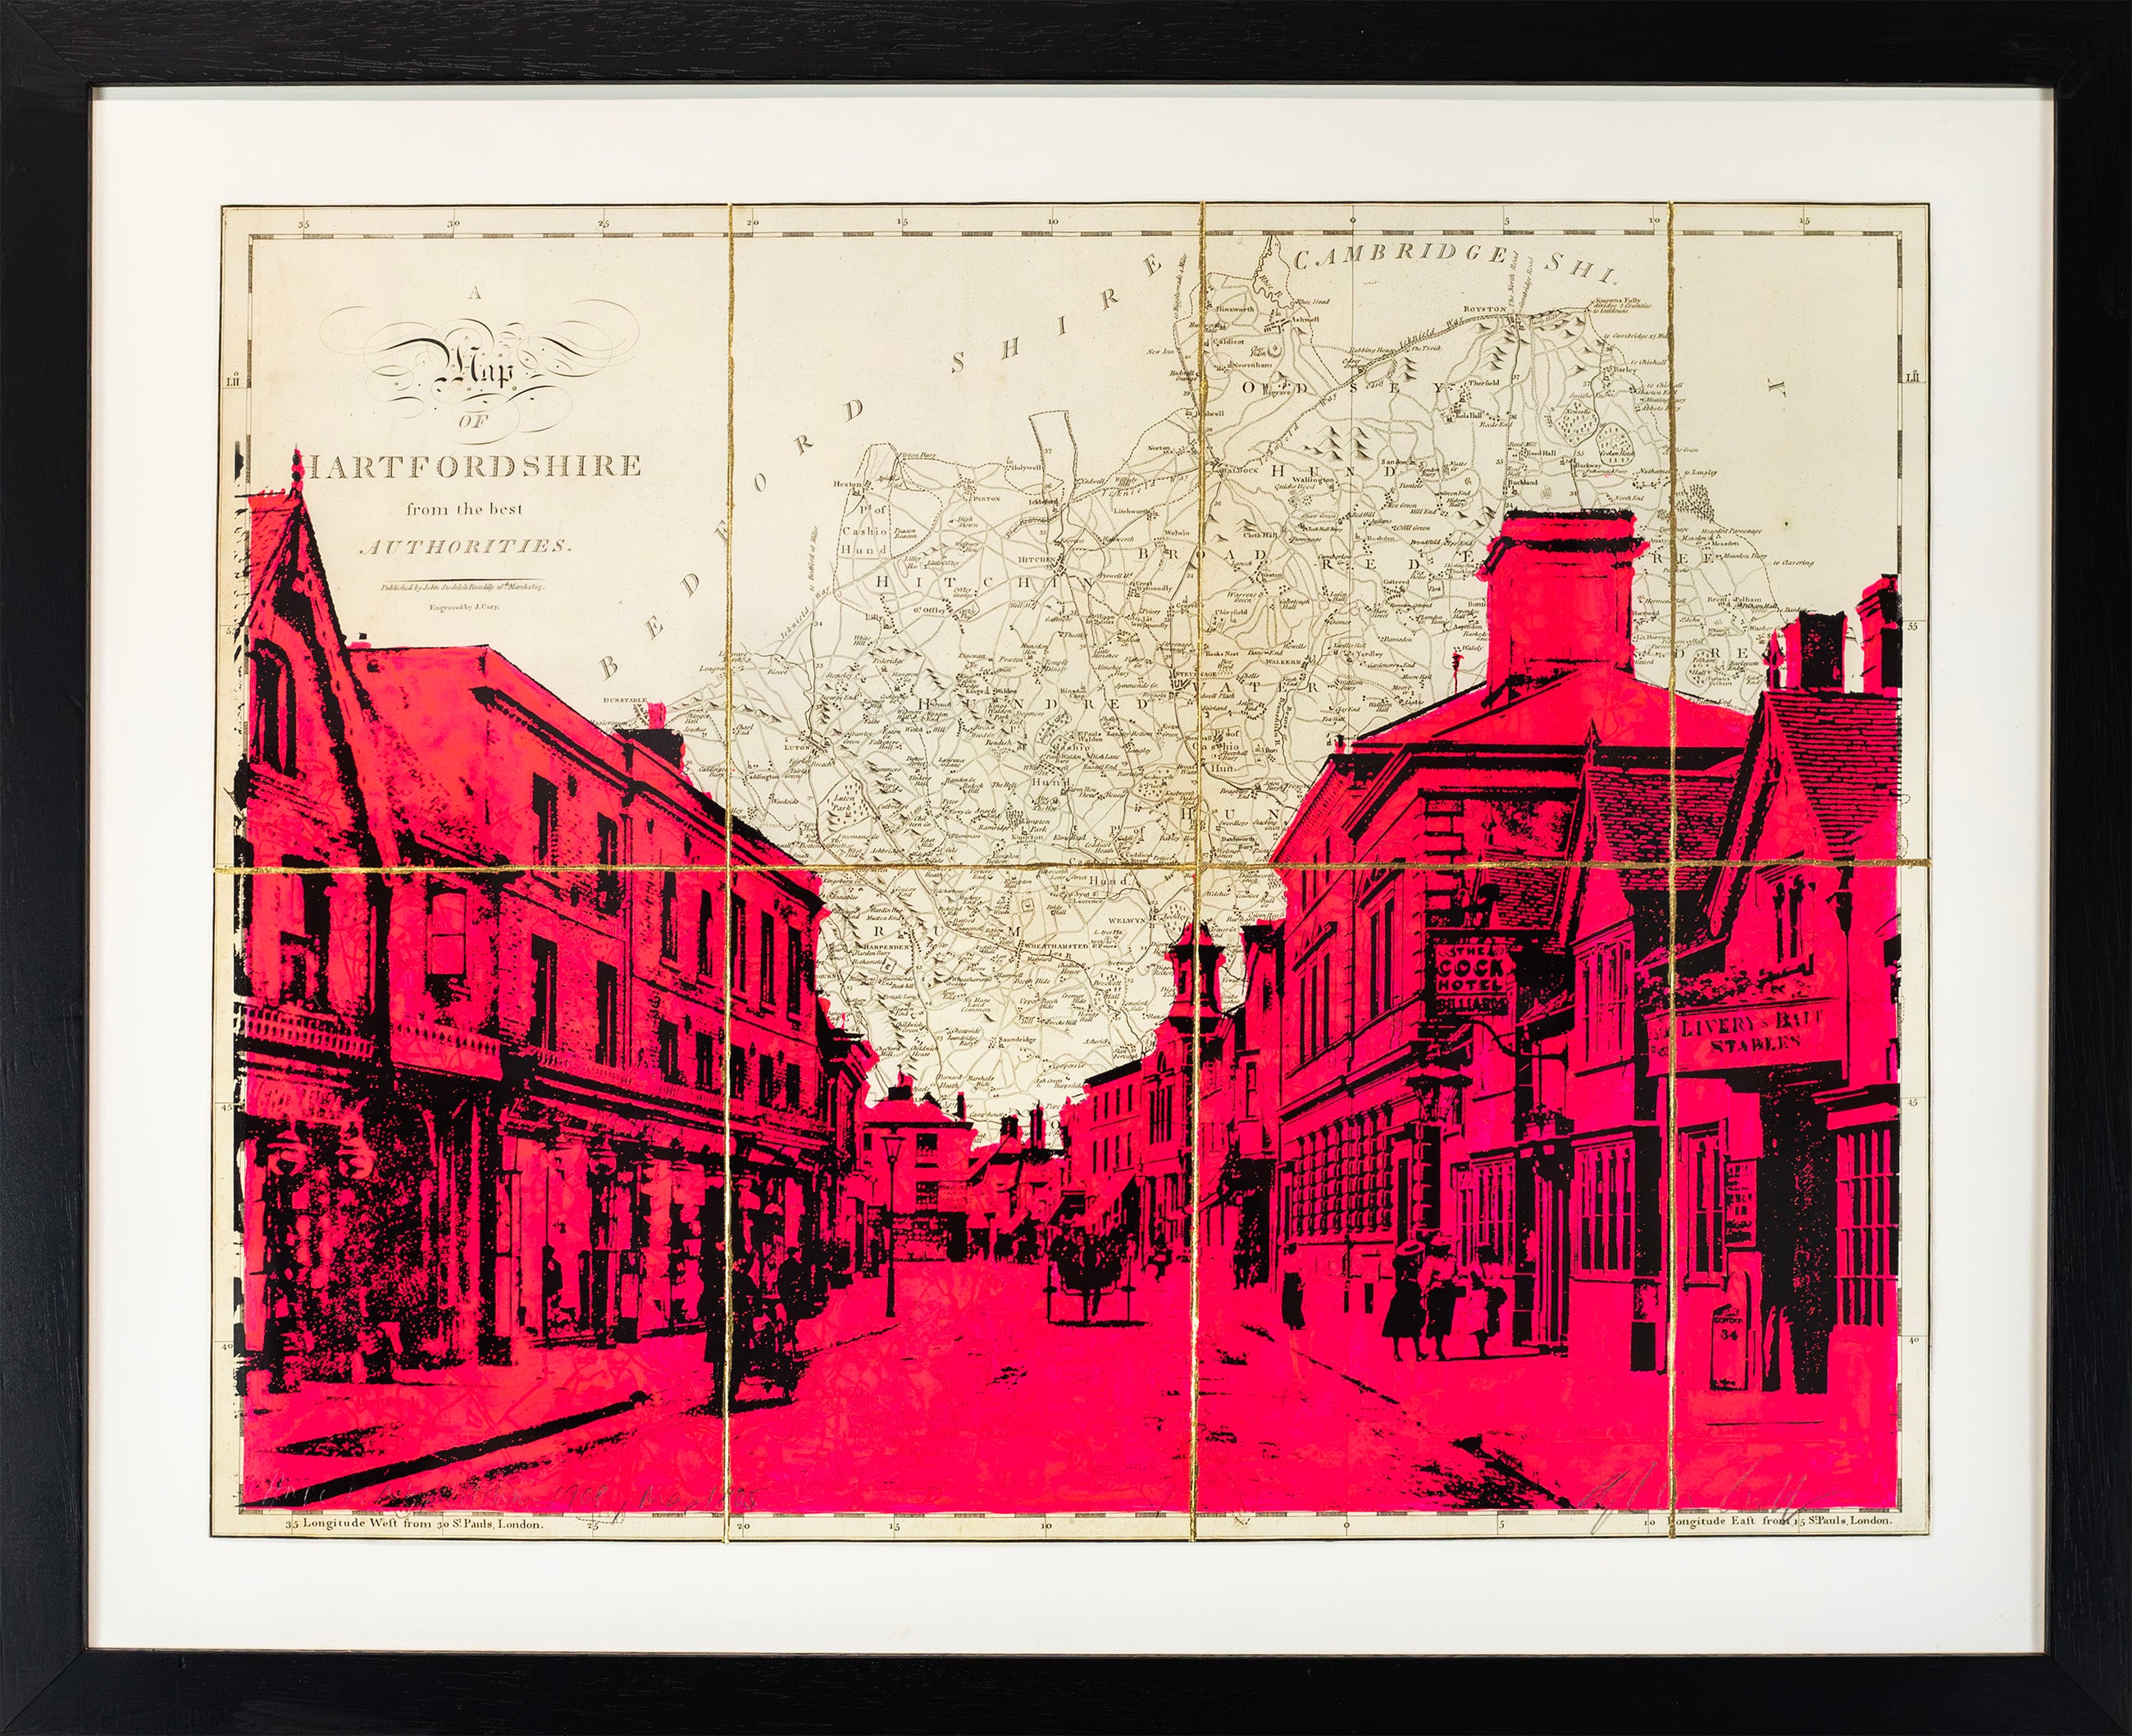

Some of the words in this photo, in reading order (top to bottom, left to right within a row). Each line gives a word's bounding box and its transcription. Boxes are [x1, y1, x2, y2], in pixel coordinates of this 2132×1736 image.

[298, 220, 309, 230] 35
[448, 219, 460, 229] 30
[598, 220, 609, 230] 25
[897, 217, 909, 226] 15
[1504, 217, 1510, 226] 5
[1293, 243, 1507, 271] CAMBRIDGE
[1545, 252, 1617, 285] SHI.
[1510, 249, 1519, 271] Road
[469, 285, 482, 300] A
[458, 413, 490, 430] OF
[302, 453, 643, 481] HARTFORDSHIRE
[1692, 468, 1718, 477] Langley
[407, 502, 451, 516] from
[458, 503, 484, 516] the
[490, 503, 523, 516] best
[874, 505, 886, 514] of
[842, 526, 886, 536] Cashio
[358, 538, 572, 556] AUTHORITIES.
[840, 545, 886, 554] Hund
[1783, 559, 1815, 567] Clavering
[430, 604, 463, 613] Engraved
[1908, 622, 1919, 631] 55
[745, 774, 779, 782] Caddington
[1090, 877, 1131, 886] Hund.
[1456, 947, 1484, 955] THE
[1438, 959, 1504, 977] COCK
[1438, 979, 1503, 991] HOTEL
[1681, 1016, 1754, 1037] LIVERY
[1711, 1036, 1801, 1054] STABLES
[1907, 1099, 1918, 1107] 45
[1909, 1337, 1920, 1345] 40
[221, 1342, 234, 1351] 40
[285, 1520, 298, 1529] 35
[303, 1518, 365, 1530] Longitude
[403, 1518, 430, 1528] from
[437, 1521, 449, 1529] 30
[498, 1520, 544, 1529] London.
[1499, 1521, 1506, 1529] 5
[1762, 1516, 1790, 1525] from
[1793, 1519, 1806, 1527] 15
[1851, 1516, 1893, 1526] London.
[889, 1521, 900, 1530] 15
[1041, 1521, 1053, 1530] 10
